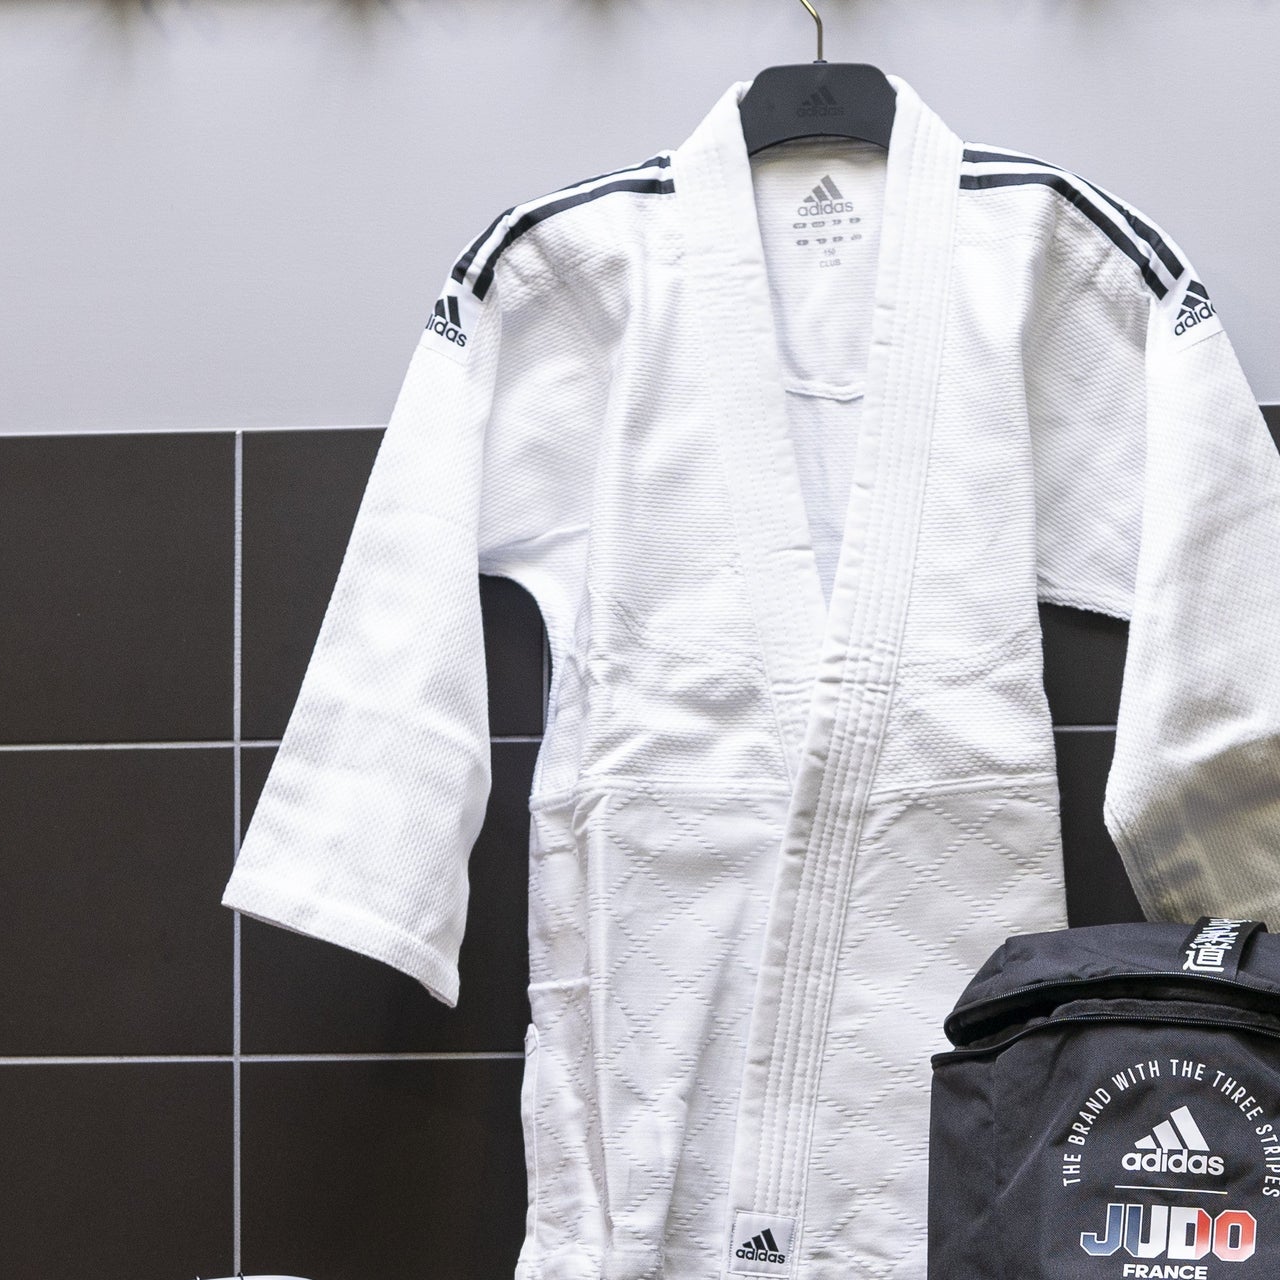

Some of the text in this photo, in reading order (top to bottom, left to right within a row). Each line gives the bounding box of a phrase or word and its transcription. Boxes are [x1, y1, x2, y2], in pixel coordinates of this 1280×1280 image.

[797, 199, 854, 216] adidas
[425, 313, 468, 347] idas
[1111, 1060, 1160, 1091] WITH
[1170, 1059, 1206, 1081] THE
[1212, 1070, 1264, 1121] THREE
[1067, 1087, 1112, 1146] BRAND
[1063, 1153, 1081, 1187] THE
[1121, 1149, 1225, 1176] adidas
[1080, 1203, 1257, 1262] JUDO
[735, 1248, 786, 1264] adidas
[1122, 1263, 1208, 1280] FRANCE
